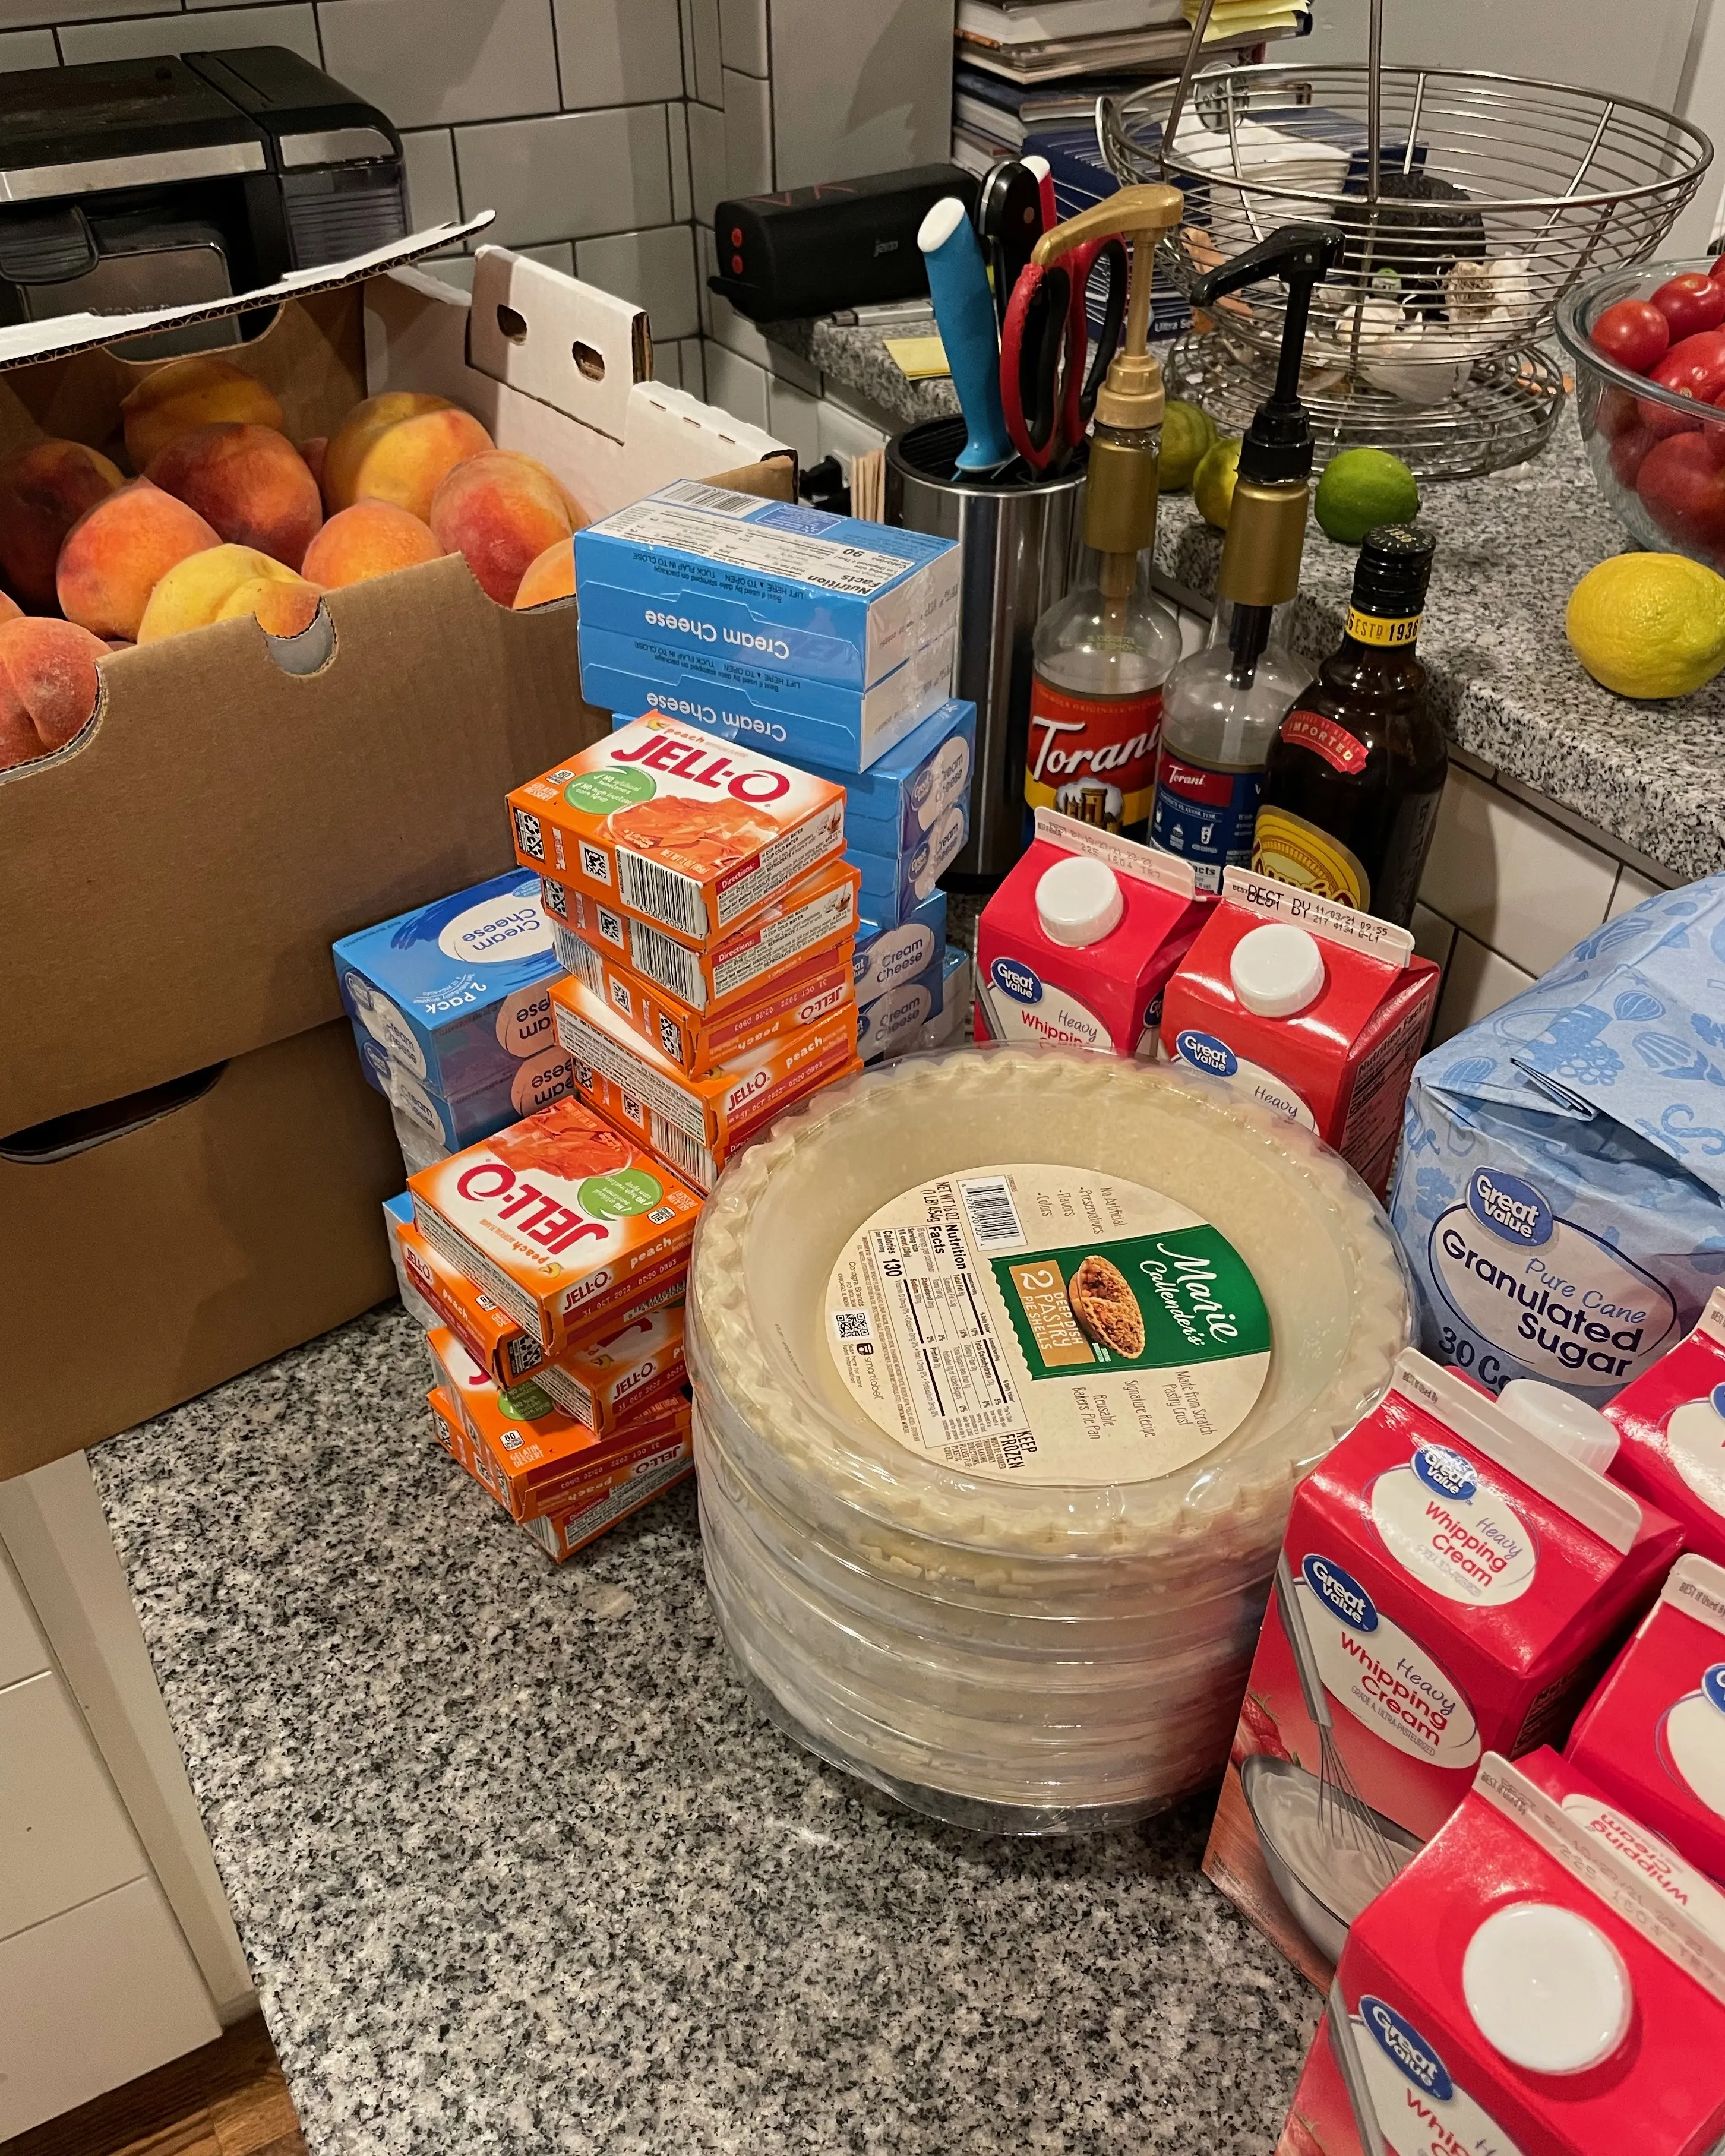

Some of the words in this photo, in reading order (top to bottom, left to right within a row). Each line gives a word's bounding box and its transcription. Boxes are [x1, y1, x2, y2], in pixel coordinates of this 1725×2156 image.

[633, 552, 657, 564] CLOSE
[843, 548, 865, 557] 90
[695, 568, 715, 578] TUCK
[725, 574, 746, 585] OPEN
[808, 574, 872, 595] Nutrition
[841, 574, 882, 587] Facts
[767, 583, 786, 595] HERE
[645, 610, 717, 642] Cheese
[1389, 619, 1418, 641] 1936
[723, 627, 789, 659] Cream
[646, 693, 716, 724] Cheese
[664, 727, 705, 743] peach
[722, 712, 786, 742] Cream
[1032, 710, 1164, 780] Torani
[1289, 722, 1353, 761] IMPORTED
[610, 735, 790, 803] JELL-O
[1169, 764, 1206, 785] Torani
[786, 837, 798, 849] WATER
[790, 827, 803, 840] WATER
[721, 862, 756, 889] Directions:
[789, 915, 803, 924] WATER
[795, 906, 808, 915] WATER
[1247, 884, 1284, 911] BEST
[1291, 897, 1311, 918] BY
[1315, 905, 1355, 925] 11/03/21
[1360, 921, 1388, 937] 09:55
[1313, 915, 1328, 926] 217
[462, 909, 536, 943] Cheese
[472, 920, 541, 951] Cream
[718, 939, 754, 962] Directions:
[882, 938, 922, 967] Cream
[877, 951, 922, 982] Cheese
[997, 963, 1033, 991] Great
[470, 982, 487, 991] 2
[801, 985, 814, 998] OCT
[1005, 979, 1032, 998] Value
[425, 992, 476, 1014] Pack
[781, 995, 797, 1007] 2022
[801, 986, 843, 1019] JELL-O
[880, 997, 920, 1026] Cream
[738, 1022, 779, 1049] peach
[1057, 1010, 1098, 1042] Heavy
[786, 1036, 823, 1070] peach
[1184, 1036, 1227, 1064] Great
[1193, 1051, 1225, 1071] Value
[728, 1071, 767, 1112] JELL-O
[1255, 1086, 1298, 1119] Heavy
[635, 1195, 646, 1204] NO
[672, 1190, 697, 1208] DESSERT
[936, 1181, 952, 1193] NET
[940, 1194, 955, 1203] WT
[1100, 1187, 1114, 1196] No
[1476, 1174, 1539, 1226] Great
[457, 1164, 609, 1255] JELL-O
[614, 1203, 624, 1212] NO
[666, 1194, 690, 1212] GELATIN
[922, 1196, 937, 1207] LB)
[926, 1207, 941, 1223] 454g
[1037, 1196, 1052, 1216] Colors
[1079, 1190, 1104, 1234] Preservatives
[1105, 1198, 1128, 1226] Artificial
[651, 1213, 663, 1222] 80
[946, 1212, 960, 1221] OZ
[971, 1216, 983, 1235] 20100
[1484, 1199, 1533, 1238] Value
[512, 1239, 551, 1265] peach
[630, 1237, 672, 1269] peach
[883, 1231, 896, 1254] Calories
[929, 1226, 946, 1254] Facts
[945, 1225, 967, 1269] Nutrition
[407, 1248, 431, 1280] JELL-O
[882, 1259, 903, 1276] 130
[564, 1272, 608, 1311] JELL-O
[583, 1308, 591, 1318] 31
[596, 1297, 610, 1309] OCT
[615, 1285, 631, 1298] 2022
[638, 1270, 656, 1285] 02:20
[849, 1262, 859, 1285] Conagra
[854, 1287, 864, 1307] Brands
[1020, 1269, 1054, 1291] 2
[1156, 1242, 1239, 1344] Marie
[1443, 1229, 1644, 1352] Granulated
[1525, 1257, 1576, 1297] Pure
[1582, 1290, 1646, 1323] Cane
[443, 1289, 469, 1321] peach
[1140, 1260, 1206, 1346] Callender's
[1022, 1295, 1034, 1313] PIE
[1028, 1313, 1053, 1351] SHELLS
[1034, 1294, 1073, 1348] PASTRY
[1053, 1292, 1070, 1319] DEEP
[1065, 1319, 1083, 1345] DISH
[930, 1347, 939, 1362] Protein
[975, 1340, 983, 1351] Total
[1439, 1326, 1475, 1367] 30
[1518, 1312, 1634, 1377] Sugar
[614, 1362, 653, 1400] JELL-O
[865, 1357, 882, 1399] smartlabel
[1174, 1371, 1196, 1390] Made
[618, 1403, 626, 1411] 31
[630, 1392, 642, 1403] OCT
[1093, 1395, 1116, 1427] Reusable
[1122, 1380, 1146, 1414] Signature
[1138, 1415, 1156, 1437] Recipe
[1162, 1384, 1181, 1406] Pastry
[1172, 1408, 1193, 1426] Crust
[1183, 1392, 1201, 1408] from
[1081, 1413, 1096, 1424] Pie
[1085, 1425, 1101, 1439] Pan
[1192, 1409, 1217, 1436] Scratch
[504, 1433, 516, 1441] 80
[1016, 1430, 1037, 1452] KEEP
[510, 1444, 541, 1461] GELATIN
[513, 1450, 544, 1468] DESSERT
[611, 1455, 628, 1468] 2022
[632, 1448, 646, 1458] OCT
[635, 1445, 681, 1474] JELL-O
[999, 1434, 1025, 1469] FROZEN
[568, 1477, 612, 1500] peach
[1427, 1468, 1459, 1495] Value
[1425, 1501, 1508, 1573] Whipping
[1476, 1517, 1523, 1560] Heavy
[1432, 1534, 1492, 1587] Cream
[1313, 1561, 1366, 1616] Great
[1322, 1583, 1361, 1623] Value
[1341, 1631, 1448, 1731] Whipping
[1397, 1658, 1456, 1716] Heavy
[1351, 1685, 1372, 1706] GRADE
[1378, 1708, 1435, 1757] ULTRA-PASTEURIZED
[1361, 1675, 1440, 1746] Cream
[1601, 1814, 1672, 1875] Cream
[1590, 1820, 1688, 1906] Whipping
[1372, 2006, 1438, 2080] Great
[1385, 2031, 1433, 2087] Value
